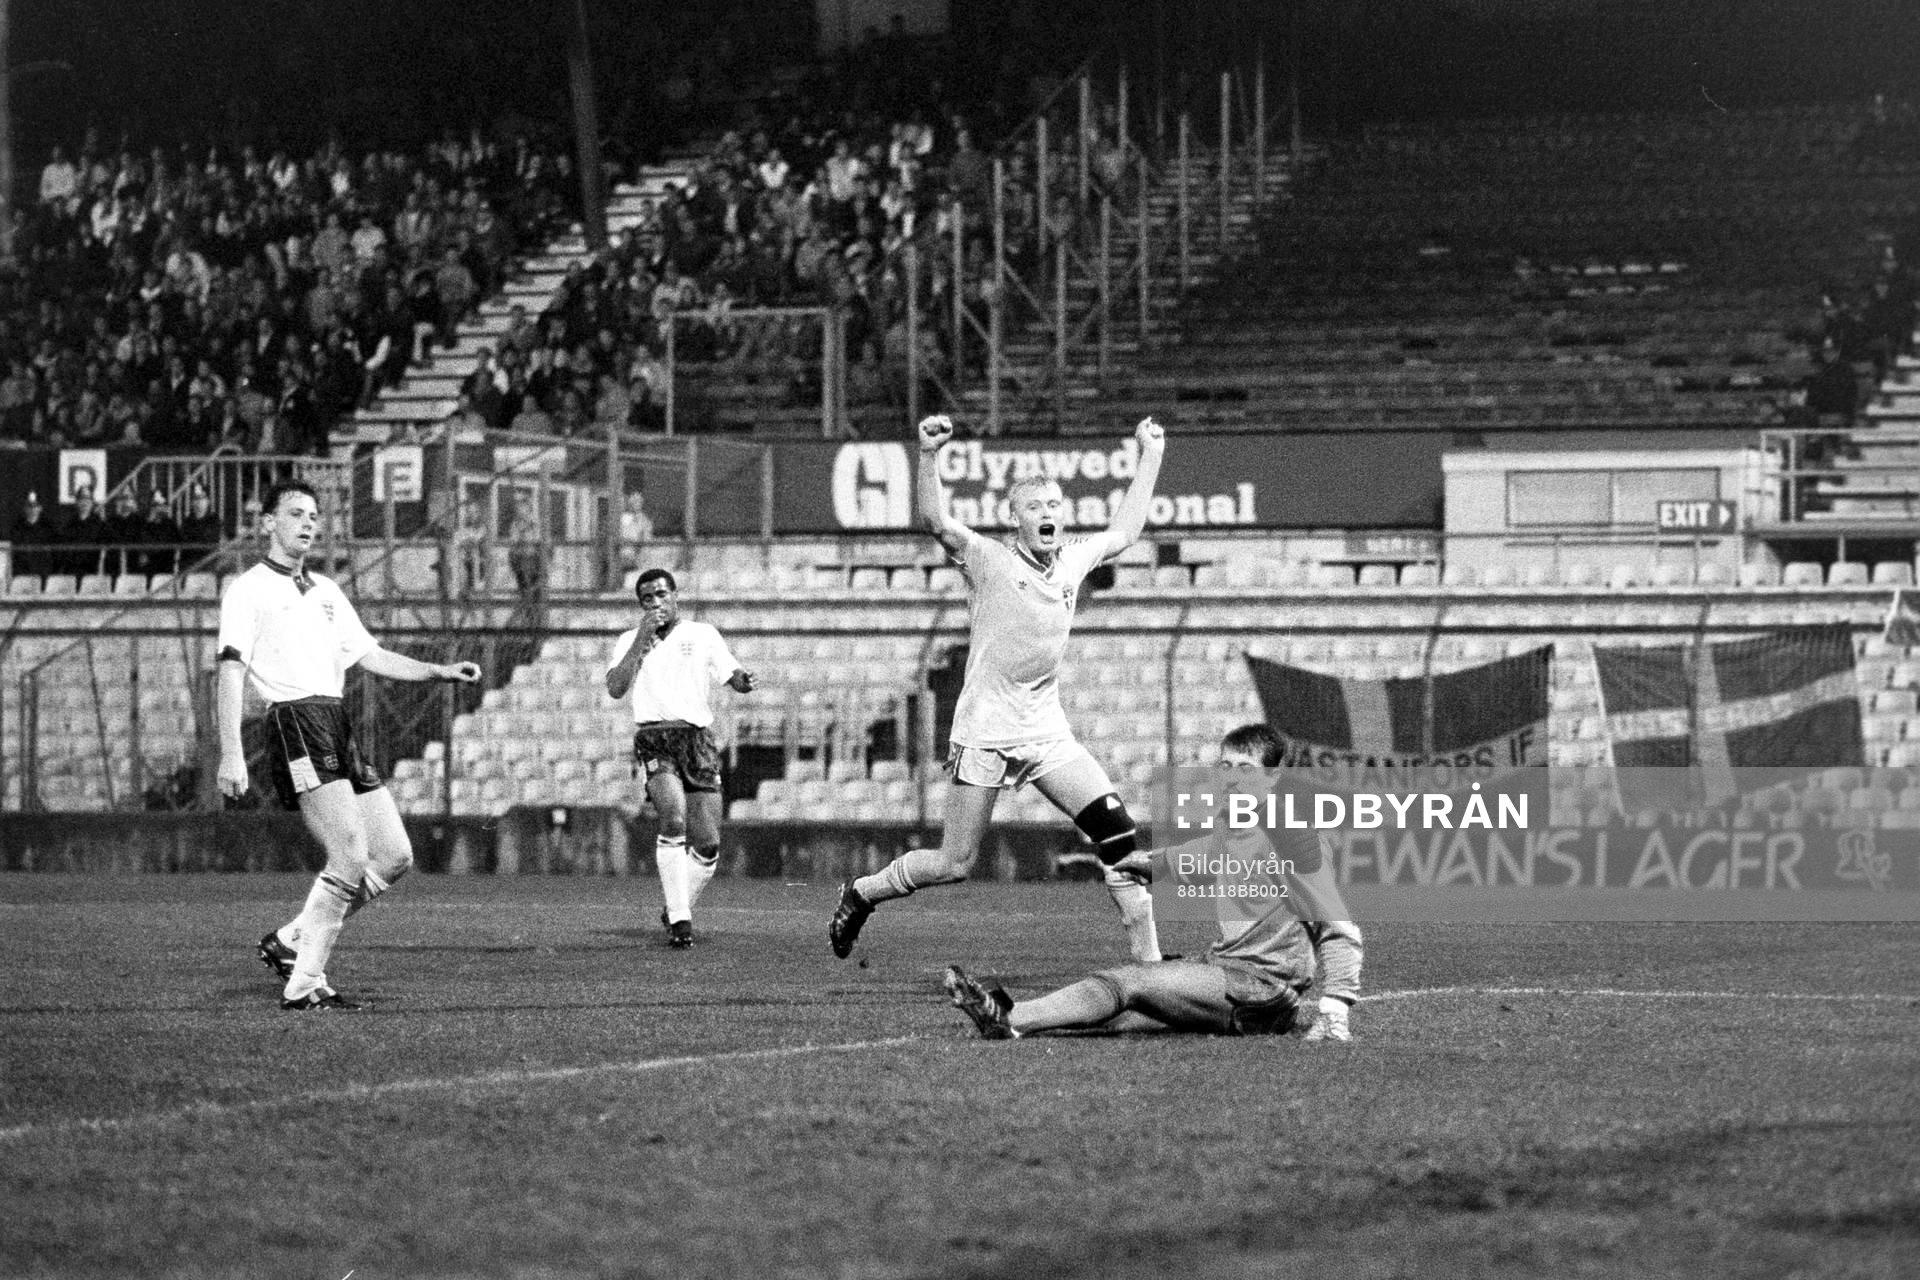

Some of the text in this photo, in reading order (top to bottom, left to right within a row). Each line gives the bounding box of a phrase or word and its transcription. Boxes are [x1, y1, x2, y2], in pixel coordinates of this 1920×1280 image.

[384, 461, 412, 497] E
[939, 439, 1140, 488] Glynwed
[1660, 502, 1711, 527] EXIT
